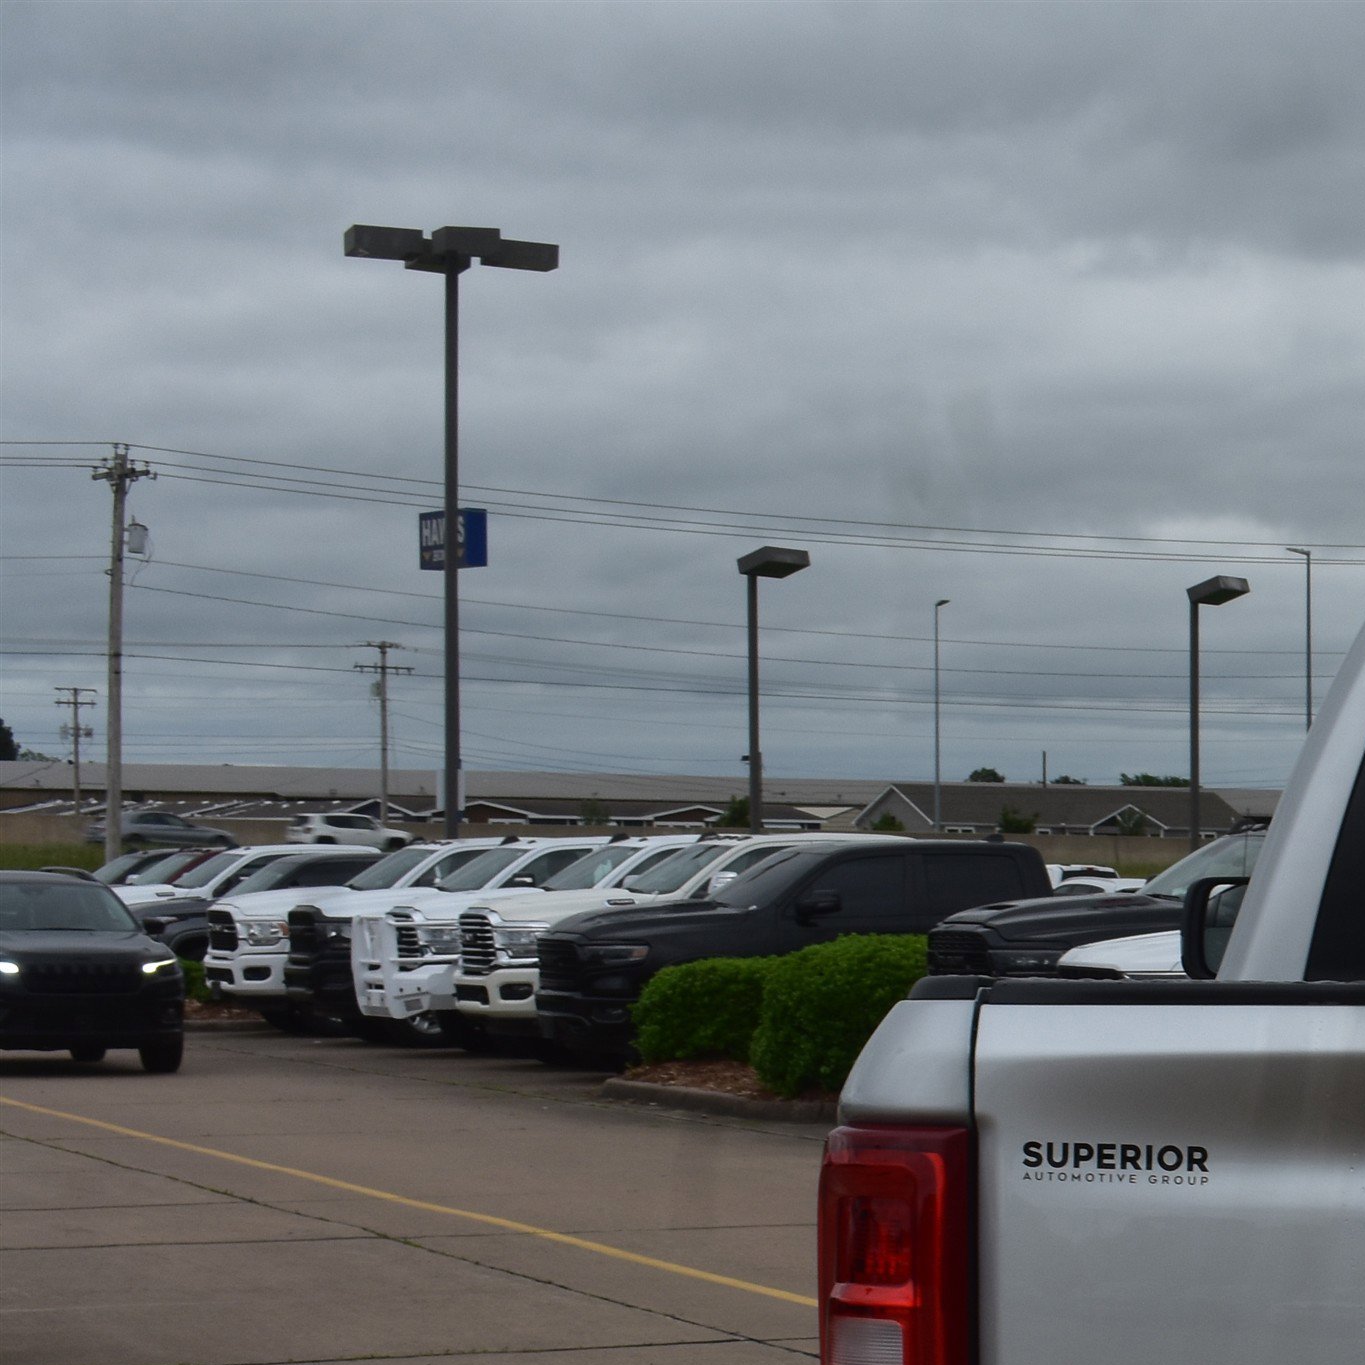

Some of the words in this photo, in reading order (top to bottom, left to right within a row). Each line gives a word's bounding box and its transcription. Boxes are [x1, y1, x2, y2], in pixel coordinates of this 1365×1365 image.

[422, 515, 465, 547] HAYS
[1022, 1141, 1209, 1172] SUPERIOR
[1023, 1172, 1137, 1184] AUTOMOTIVE
[1148, 1174, 1209, 1186] GROUP
